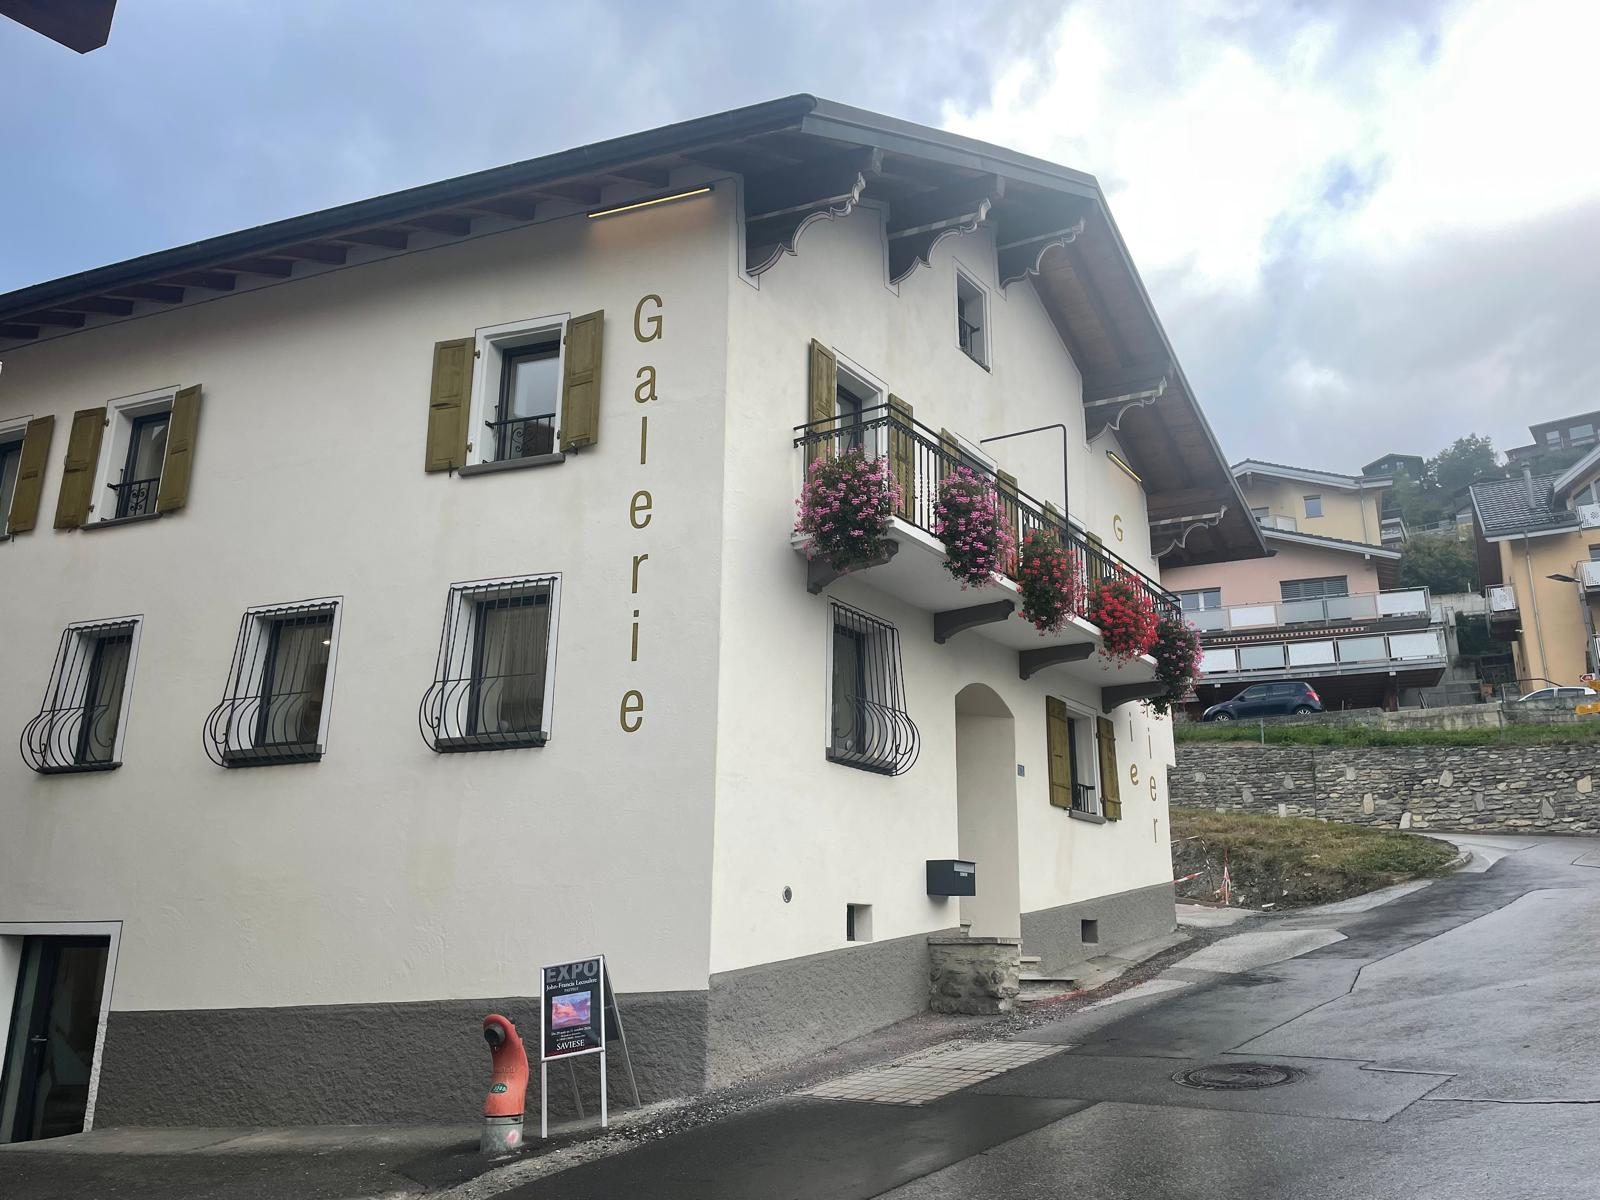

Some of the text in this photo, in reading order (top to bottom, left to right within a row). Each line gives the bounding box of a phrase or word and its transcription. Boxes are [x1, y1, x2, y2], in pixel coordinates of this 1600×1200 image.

[619, 293, 663, 733] Galerie
[546, 961, 598, 983] EXPO
[556, 1039, 585, 1051] SAVIESE
